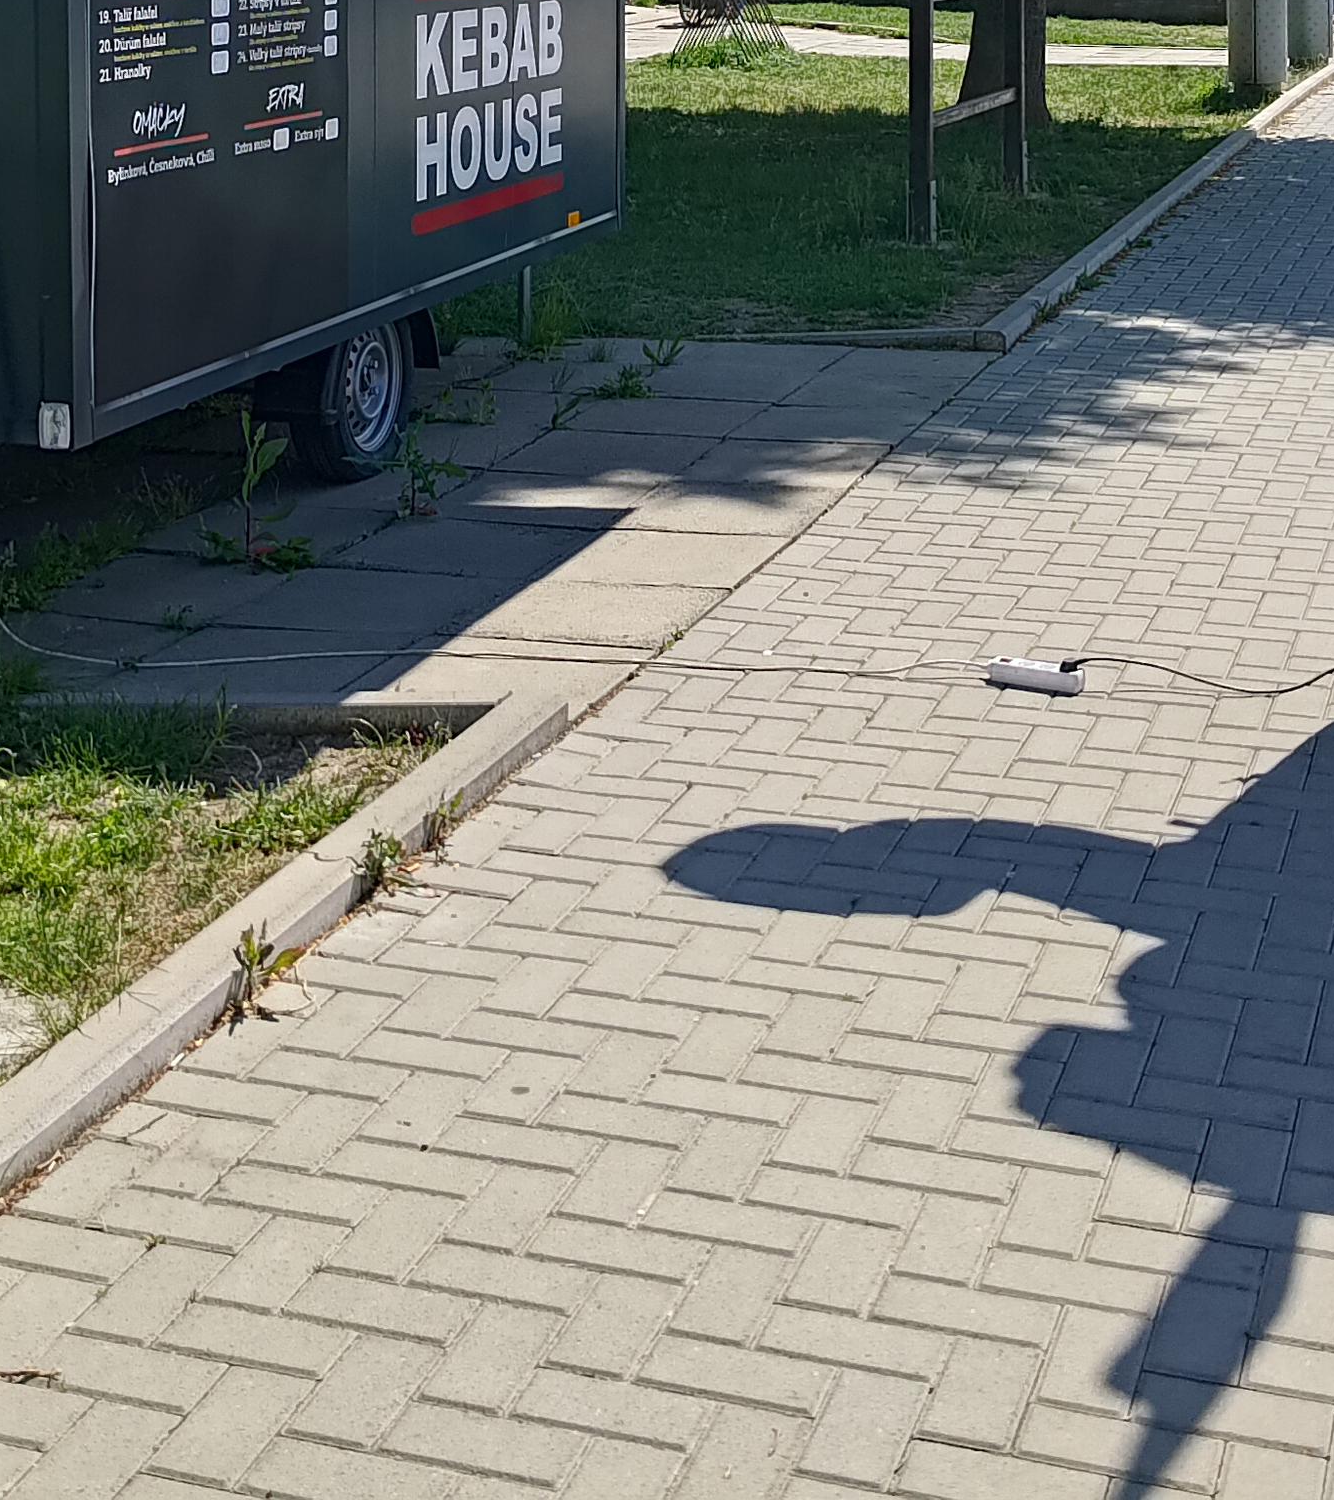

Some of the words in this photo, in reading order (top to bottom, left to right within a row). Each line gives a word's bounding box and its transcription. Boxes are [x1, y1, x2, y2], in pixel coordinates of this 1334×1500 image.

[98, 10, 111, 24] 19.
[113, 8, 133, 23] Talíř
[133, 5, 158, 20] falafel
[99, 39, 112, 53] 20.
[142, 32, 166, 49] falafel
[416, 0, 563, 99] KEBAB
[99, 68, 111, 83] 21.
[113, 63, 151, 81] Hranolky
[266, 81, 305, 113] EXTRA
[416, 87, 563, 202] HOUSE
